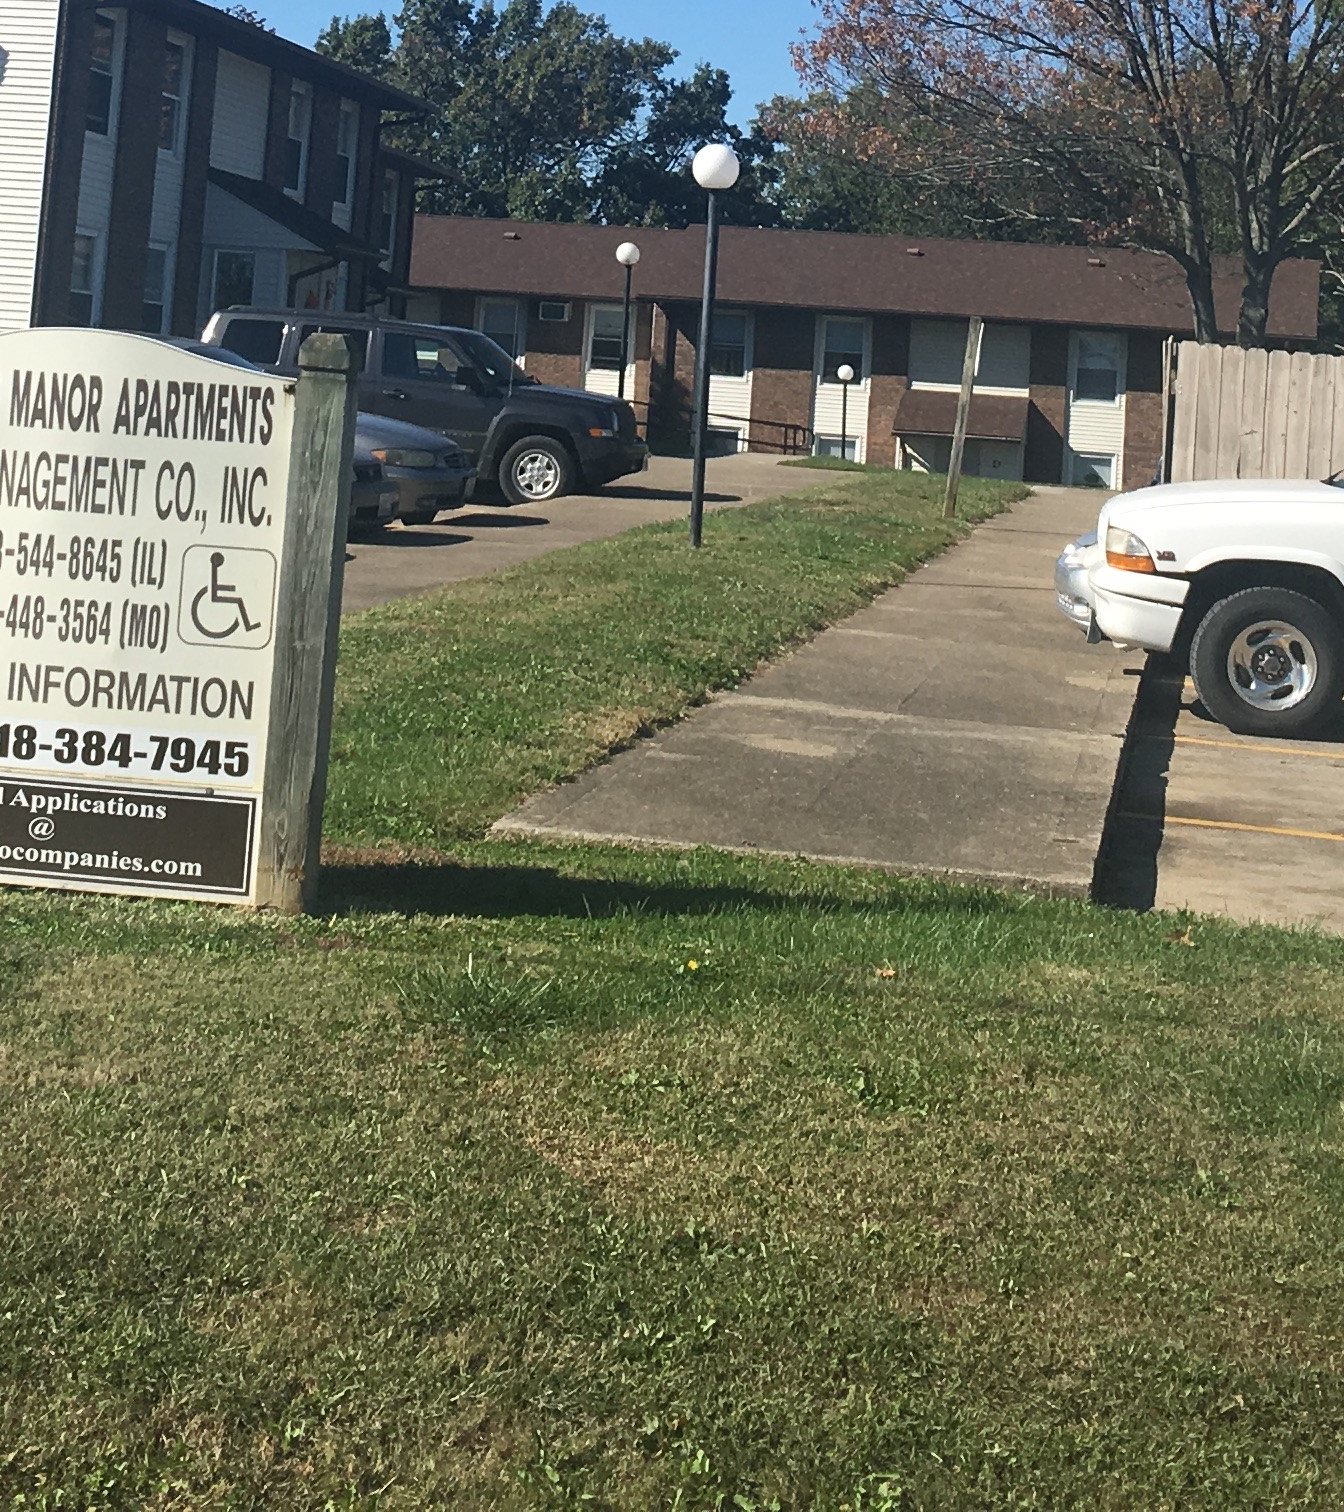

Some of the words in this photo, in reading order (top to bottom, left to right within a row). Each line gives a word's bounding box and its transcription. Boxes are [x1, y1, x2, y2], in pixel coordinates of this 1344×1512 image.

[9, 369, 103, 433] MANOR
[113, 377, 275, 446] APARTMENTS
[155, 459, 207, 535] CO.,
[220, 466, 272, 527] INC.
[131, 536, 167, 591] (IL)
[120, 598, 170, 654] (MO)
[7, 661, 255, 721] INFORMATION
[9, 788, 167, 820] Applications
[28, 816, 55, 841] @
